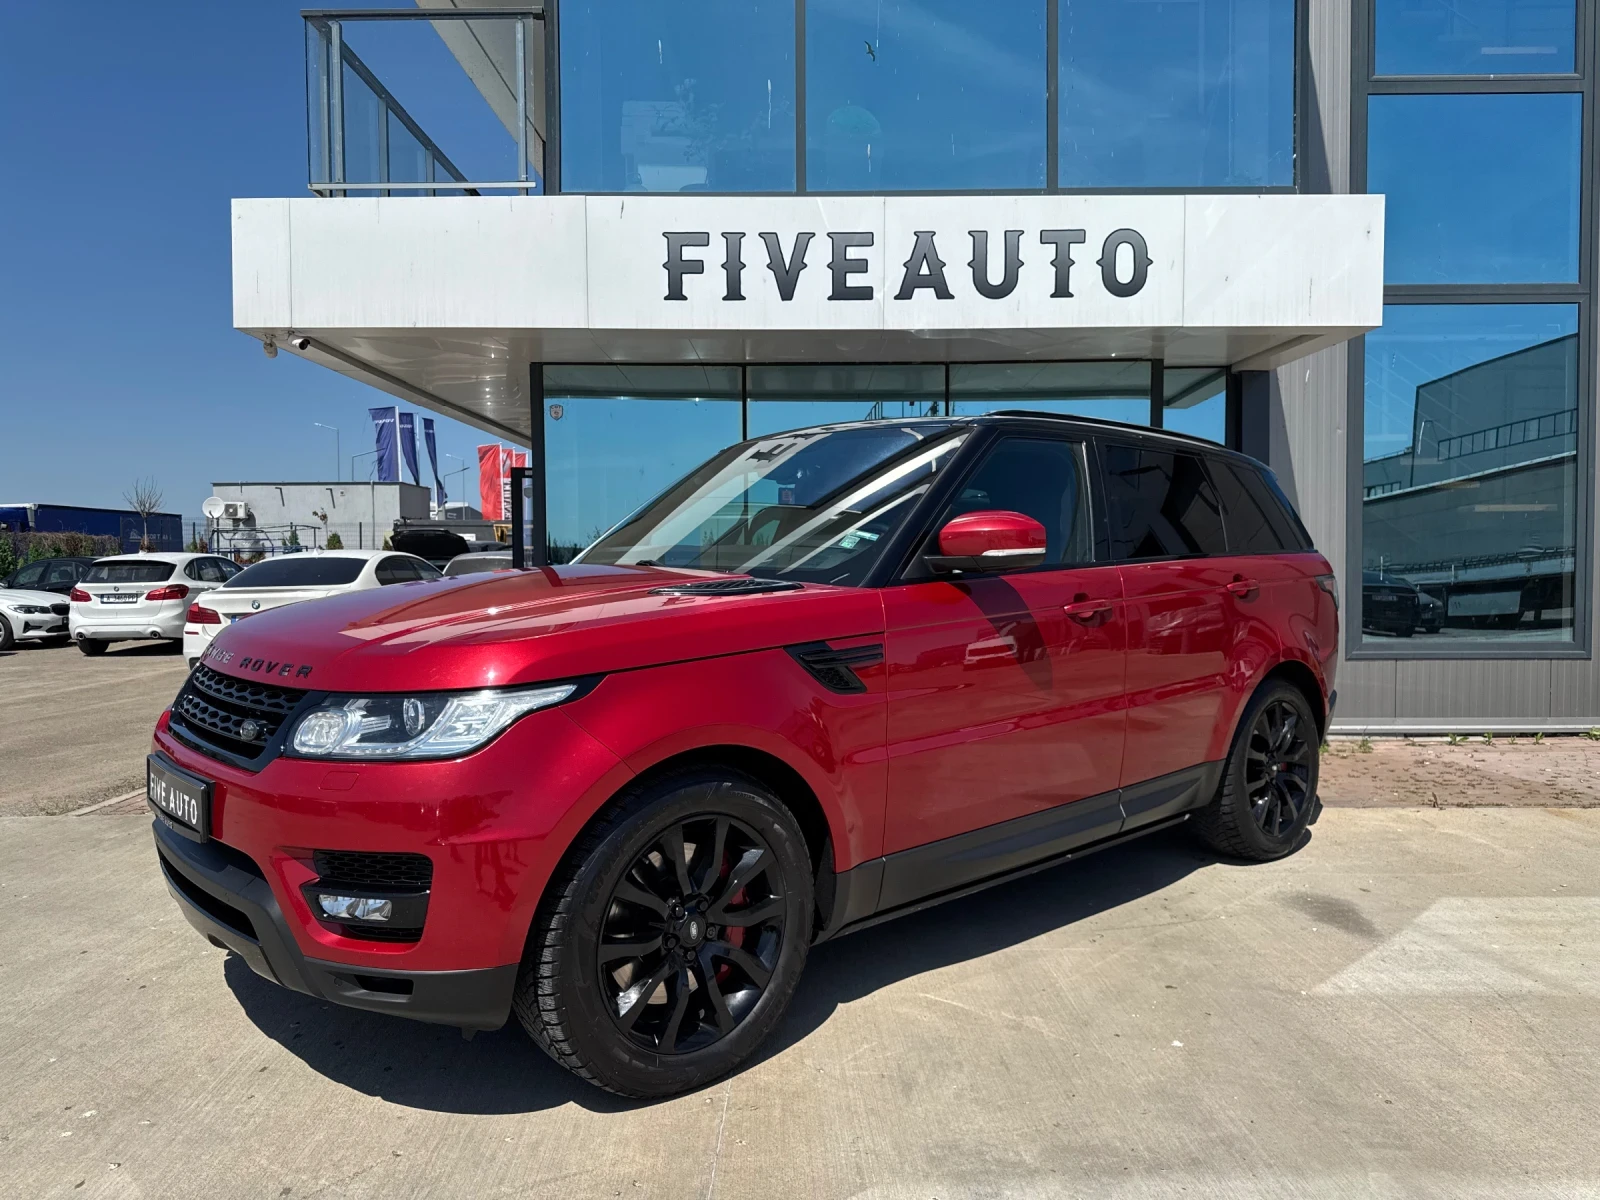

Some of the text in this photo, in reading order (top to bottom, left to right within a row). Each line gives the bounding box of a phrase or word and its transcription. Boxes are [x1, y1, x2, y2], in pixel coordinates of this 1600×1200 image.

[239, 657, 313, 679] ROVER
[150, 772, 198, 825] FIVE AUTO
